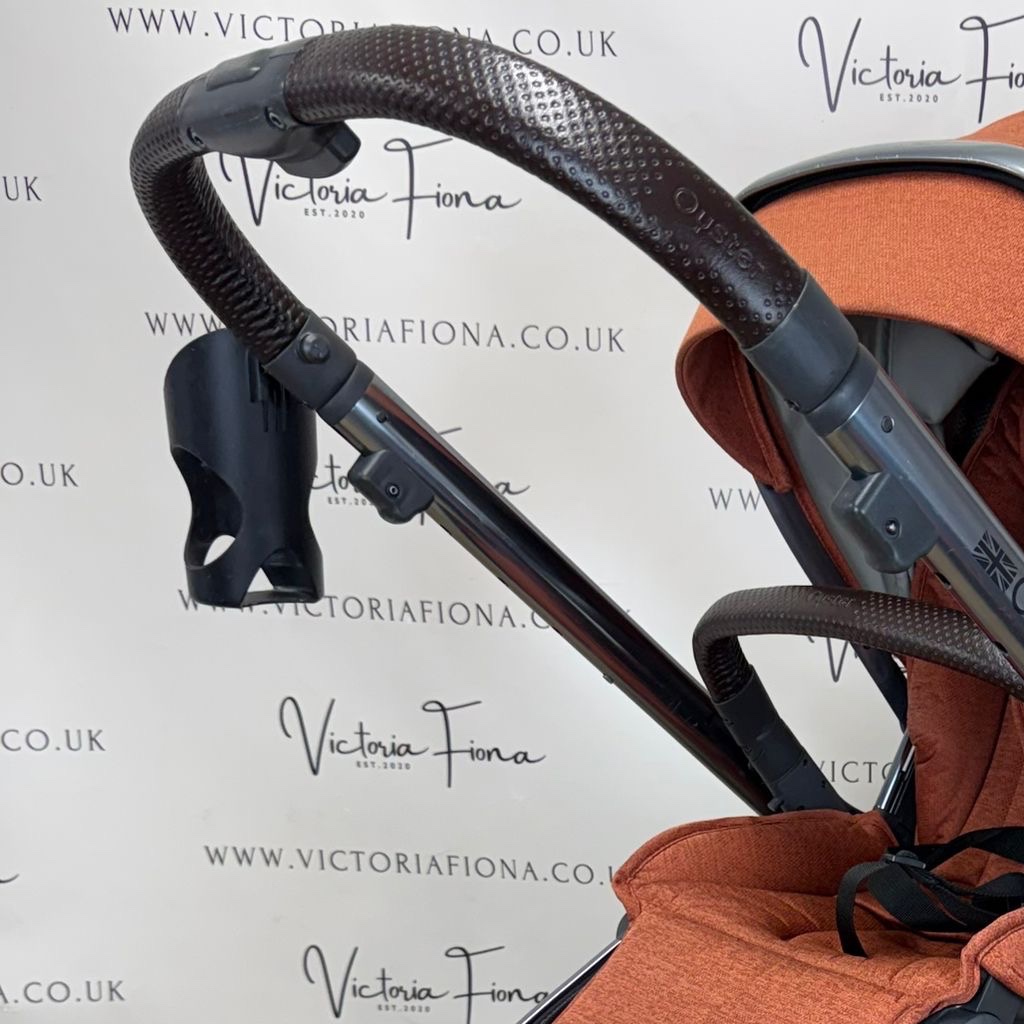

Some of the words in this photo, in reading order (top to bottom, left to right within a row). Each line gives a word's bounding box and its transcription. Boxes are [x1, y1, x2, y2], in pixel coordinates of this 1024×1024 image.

[798, 16, 962, 112] Victoria
[879, 93, 939, 103] EST.2020
[303, 208, 366, 220] EST.2020
[384, 137, 522, 240] Fiona
[674, 187, 765, 278] Oyster
[280, 696, 429, 776] Victoria
[422, 700, 546, 788] Fiona
[356, 760, 411, 770] EST.2020
[204, 845, 613, 886] WWW.VICTORIAFIONA.CO.
[303, 944, 450, 1018] Victoria
[377, 1004, 431, 1013] EST.2020
